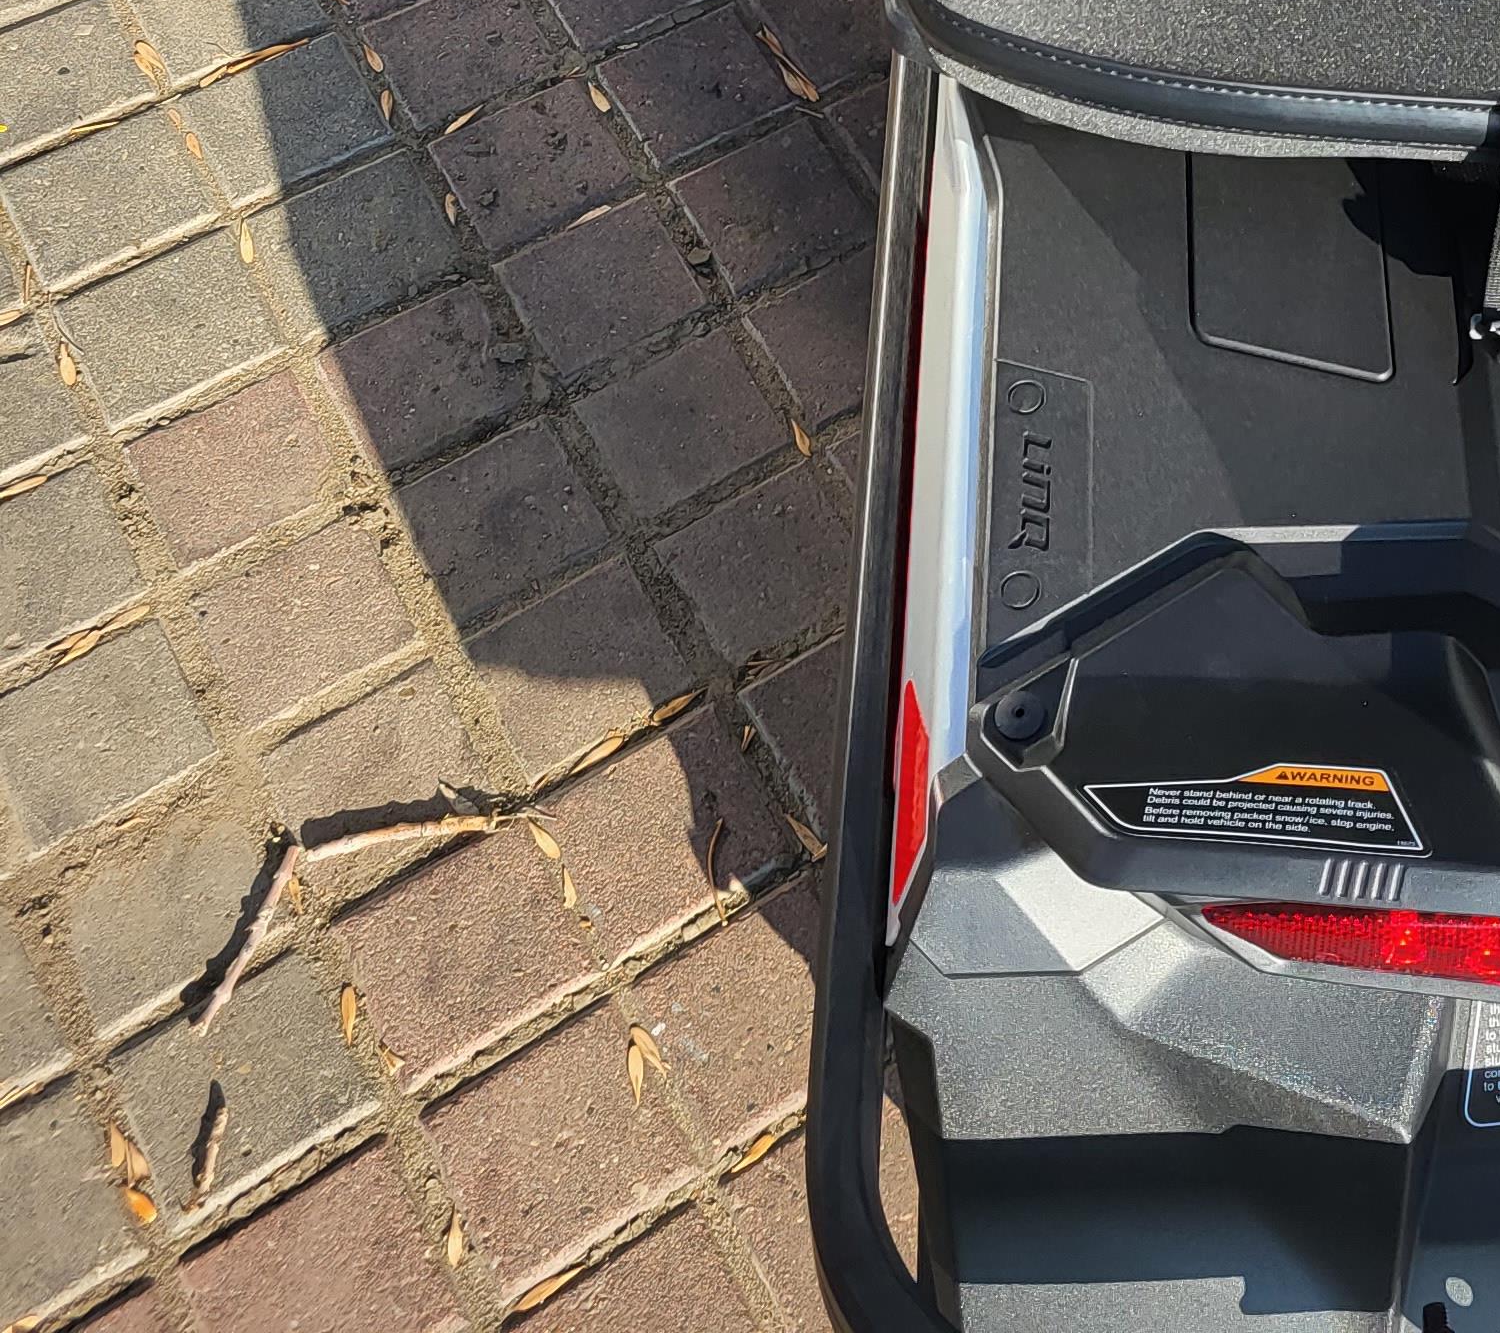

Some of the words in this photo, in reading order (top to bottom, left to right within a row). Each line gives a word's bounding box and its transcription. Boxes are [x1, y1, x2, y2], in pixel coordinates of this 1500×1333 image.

[1290, 771, 1375, 786] WARNING
[1148, 787, 1181, 797] Never
[1183, 789, 1213, 799] stand
[1215, 790, 1252, 801] behind
[1254, 794, 1266, 802] or
[1268, 795, 1292, 803] near
[1304, 797, 1345, 809] rotating
[1348, 799, 1376, 810] track.
[1144, 806, 1180, 816] Before
[1182, 809, 1231, 820] removing
[1233, 810, 1273, 822] packed
[1330, 818, 1353, 829] stop
[1147, 796, 1180, 805] Debris
[1182, 797, 1211, 807] could
[1212, 799, 1226, 807] be
[1227, 800, 1275, 811] projected
[1277, 804, 1317, 815] causing
[1319, 808, 1354, 817] severe
[1356, 809, 1395, 821] injuries.
[1142, 815, 1156, 823] tilt
[1157, 816, 1178, 824] and
[1180, 816, 1204, 826] hold
[1207, 818, 1245, 828] vehicle
[1247, 822, 1262, 830] on
[1265, 821, 1282, 831] the
[1285, 824, 1311, 834] side.
[1485, 1029, 1497, 1041] to
[1483, 1081, 1495, 1092] to
